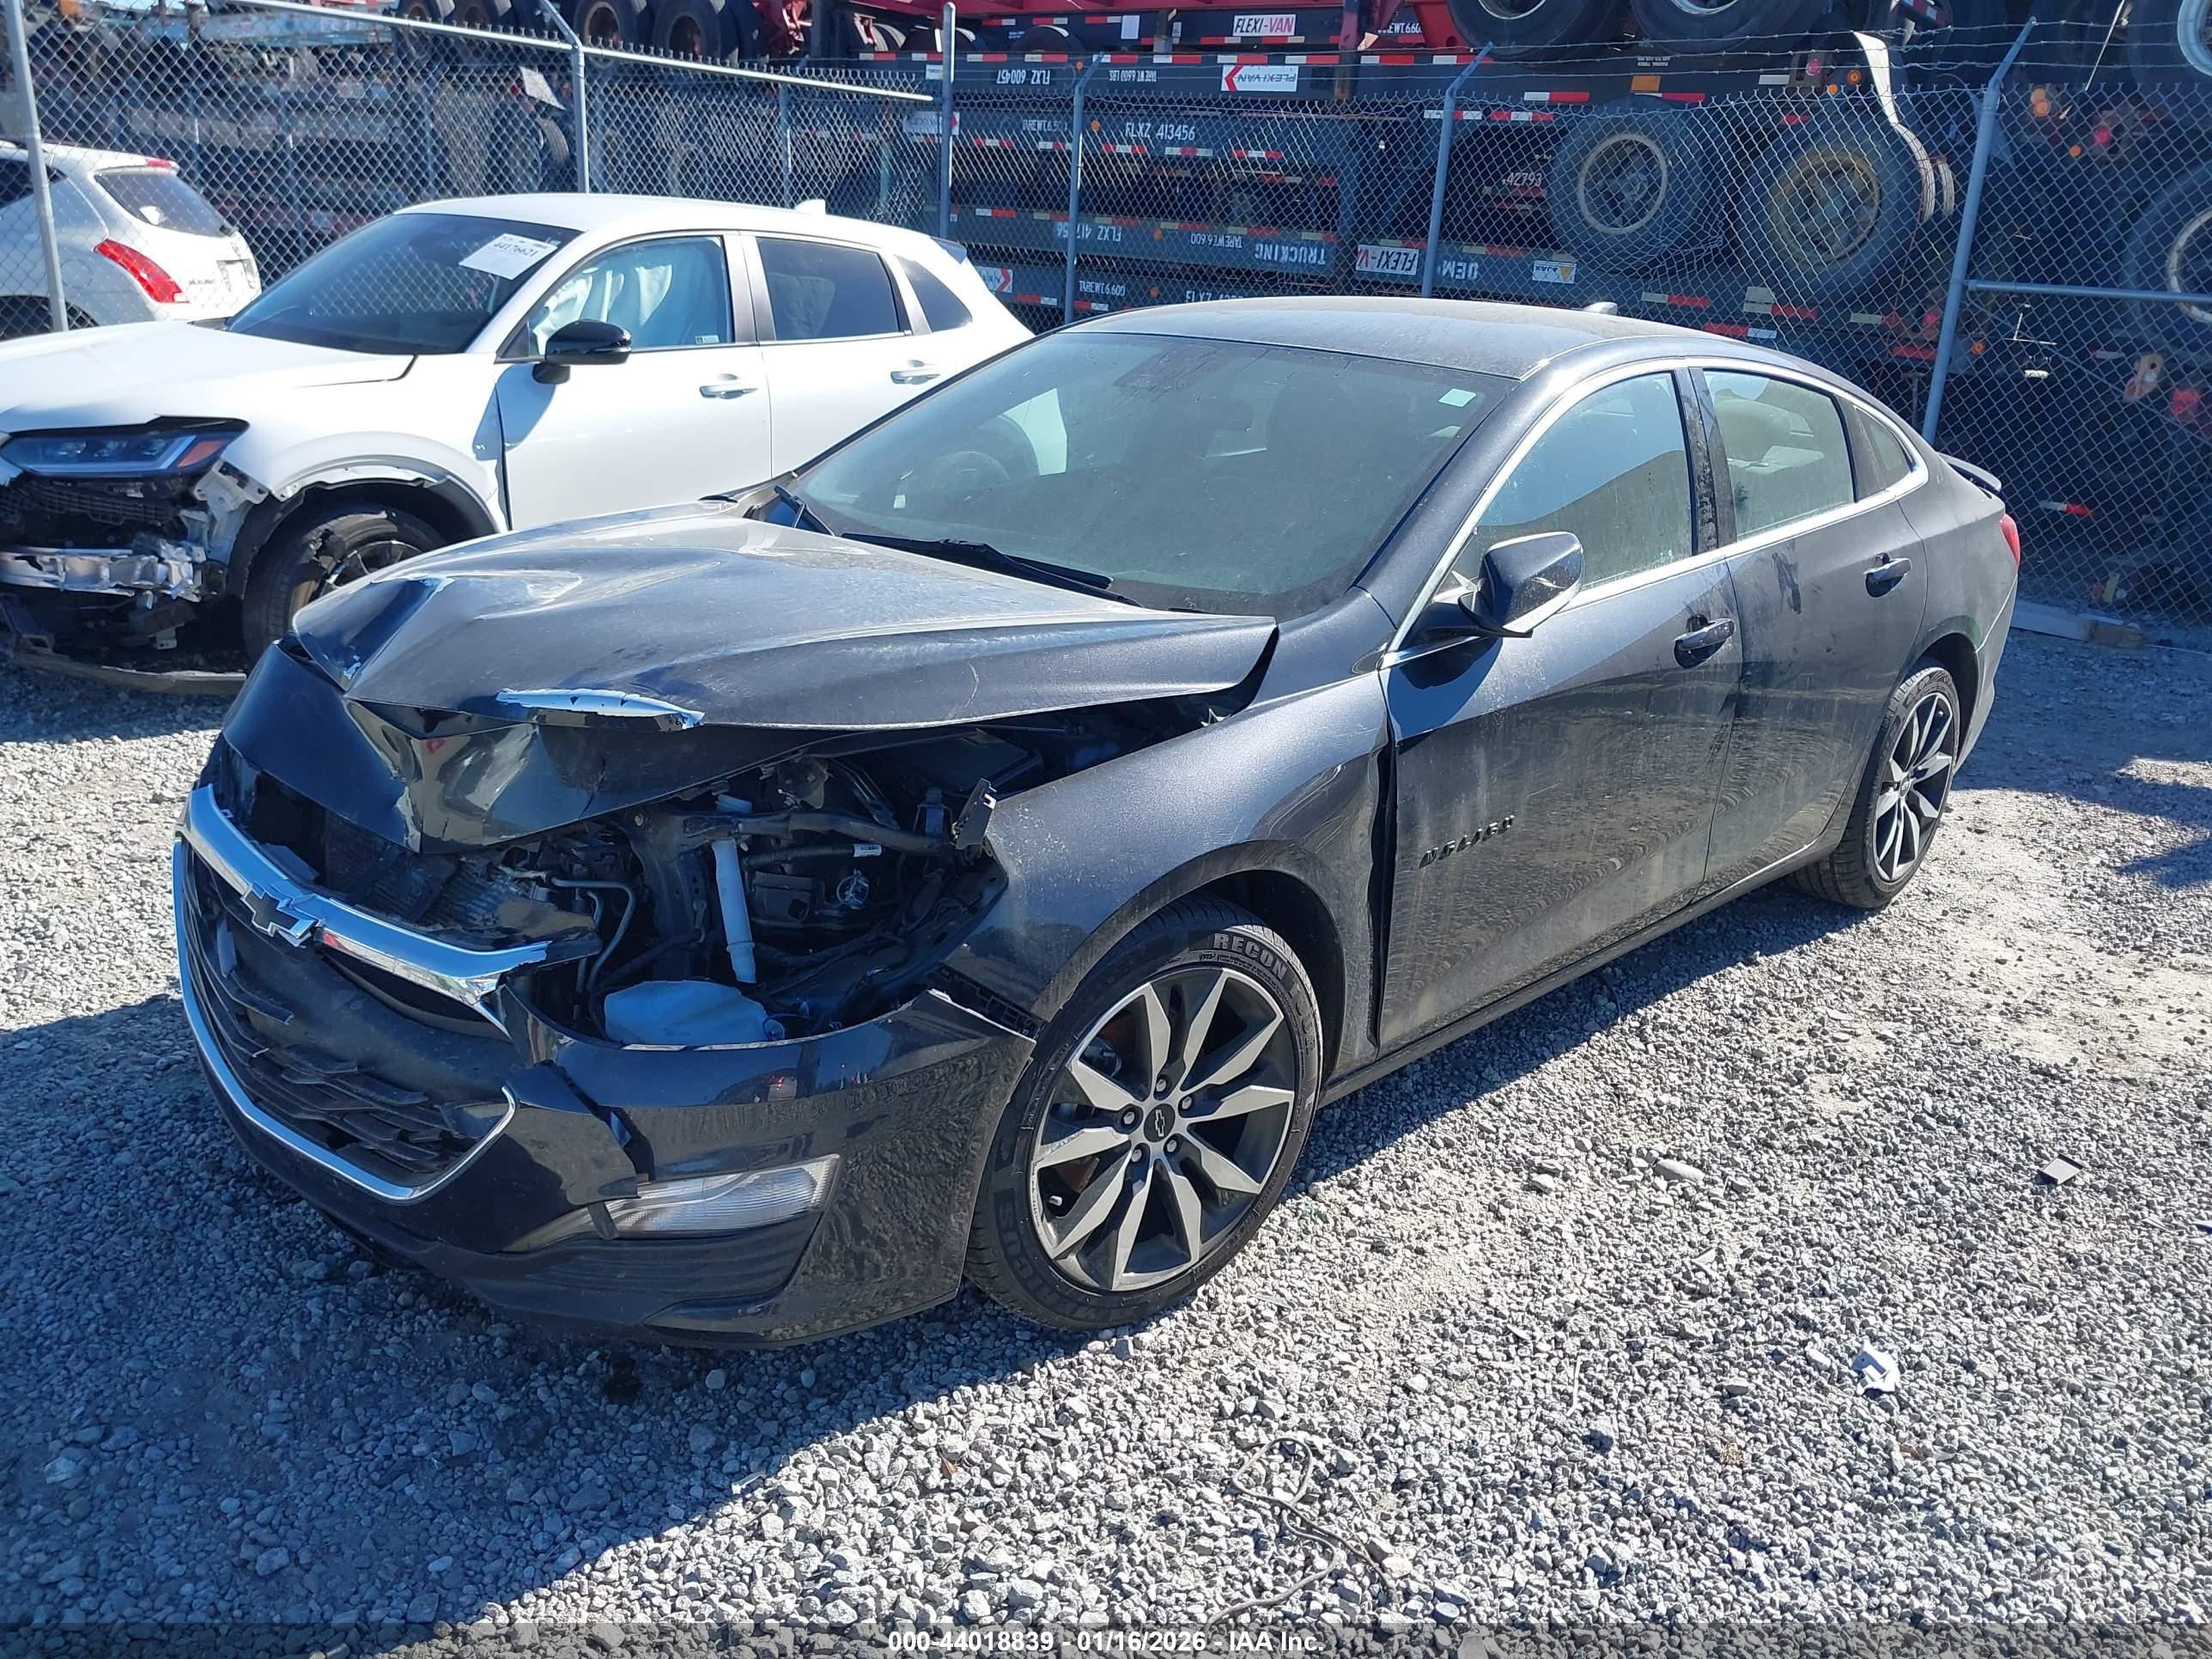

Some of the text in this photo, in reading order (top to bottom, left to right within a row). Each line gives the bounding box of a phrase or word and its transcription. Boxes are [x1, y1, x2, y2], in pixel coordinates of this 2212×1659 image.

[1234, 17, 1294, 33] FLEXI-VAN
[996, 69, 1051, 84] FLXZ 600457
[1125, 122, 1195, 141] FLXZ 413456
[1054, 222, 1121, 241] FLXZ 41756
[1255, 243, 1326, 265] TRUCKING
[1212, 932, 1287, 981] RECON
